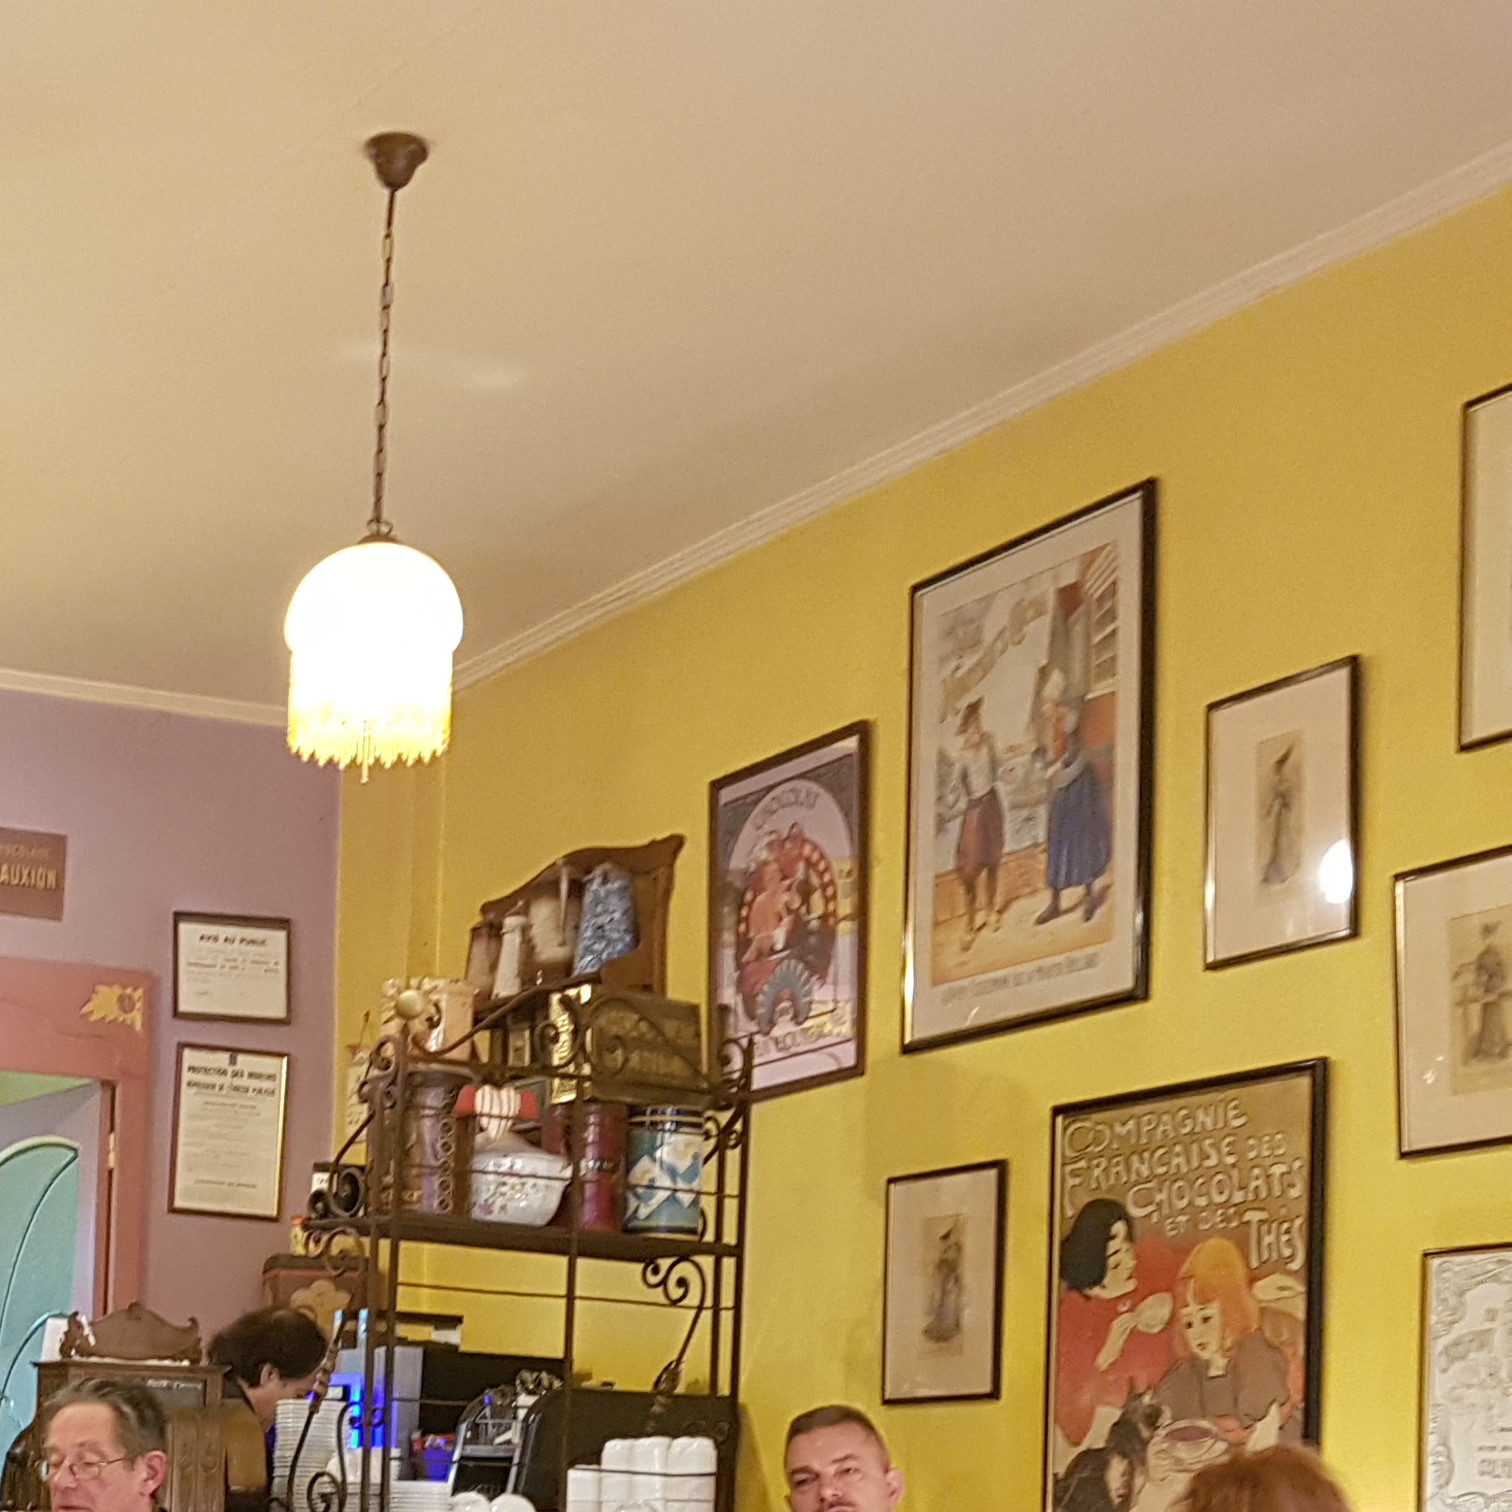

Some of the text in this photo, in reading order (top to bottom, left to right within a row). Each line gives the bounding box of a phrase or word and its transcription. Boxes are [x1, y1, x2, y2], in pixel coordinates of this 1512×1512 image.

[1247, 1132, 1287, 1160] DES
[1126, 1157, 1304, 1224] CHOCOLATS
[1164, 1215, 1189, 1237] ET
[1197, 1207, 1238, 1231] DES
